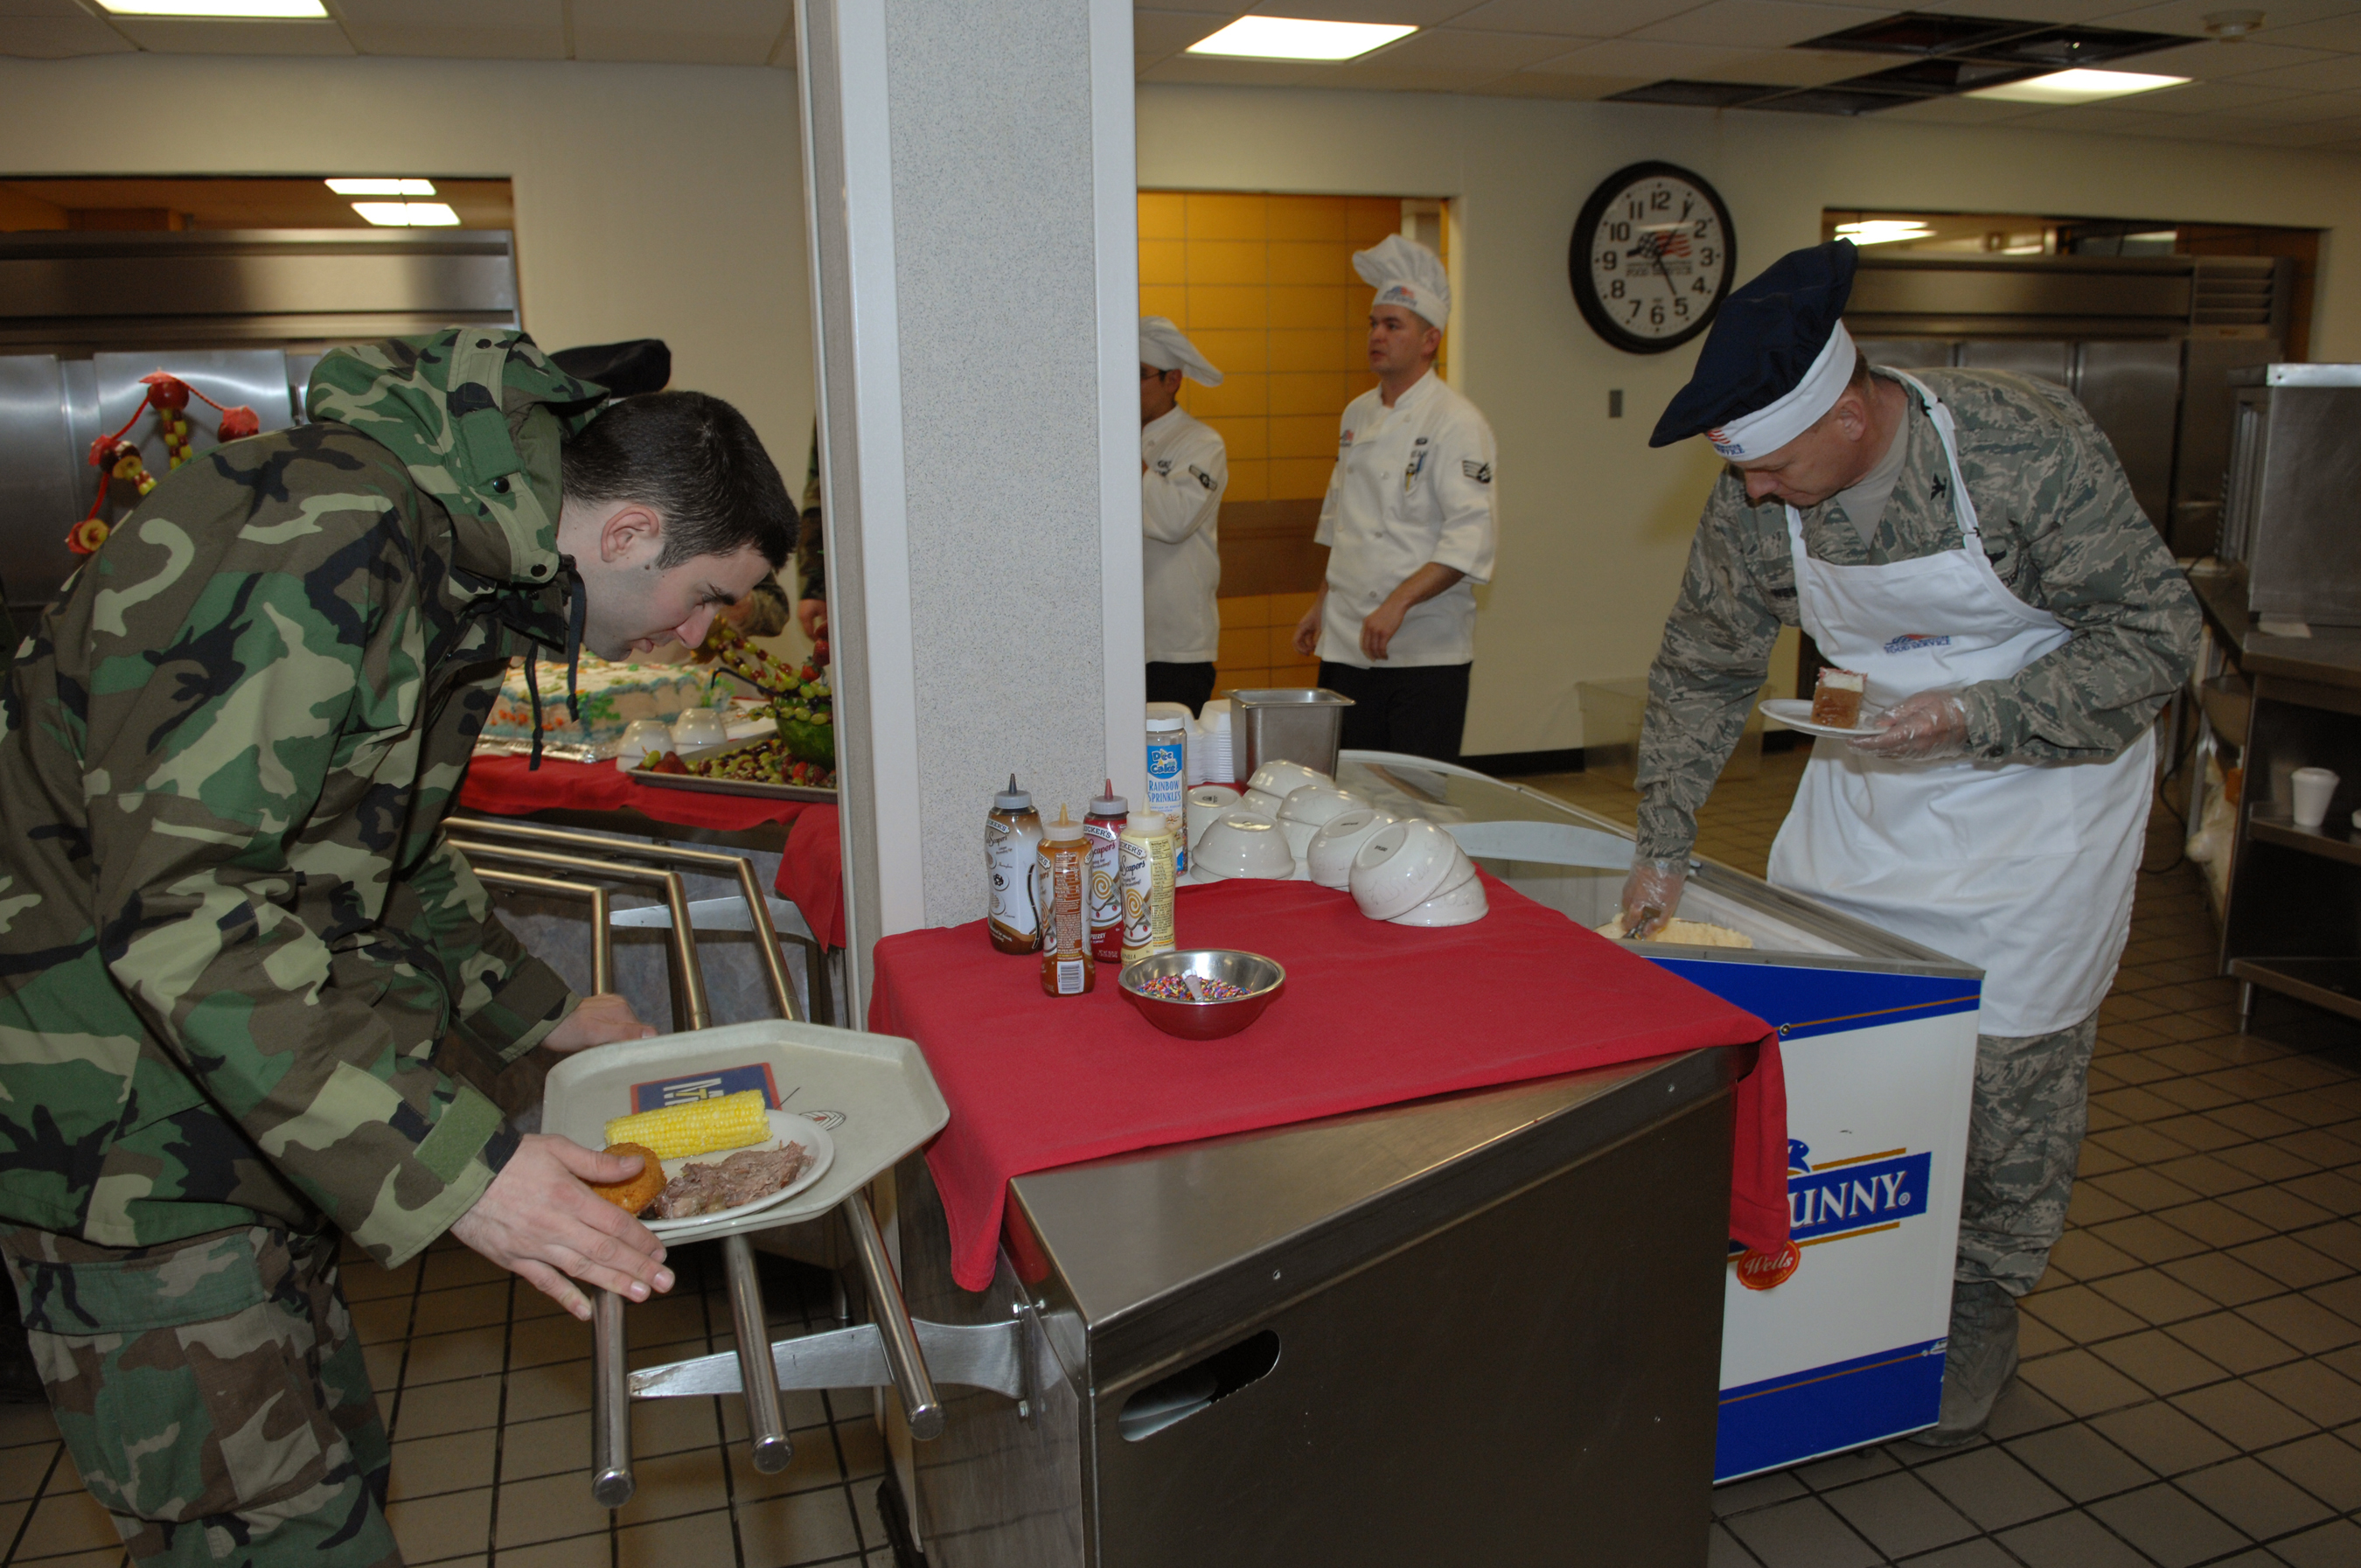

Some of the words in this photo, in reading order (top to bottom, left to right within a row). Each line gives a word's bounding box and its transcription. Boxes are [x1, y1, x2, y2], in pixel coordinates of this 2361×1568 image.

[1629, 200, 1644, 220] 11
[1650, 191, 1671, 211] 12
[1610, 222, 1630, 241] 10
[1695, 220, 1707, 239] 2
[1602, 251, 1617, 270] 9
[1700, 247, 1714, 267] 3
[1611, 279, 1625, 299] 8
[1692, 277, 1706, 295] 4
[1629, 300, 1642, 317] 7
[1650, 305, 1665, 326] 6
[1675, 297, 1689, 317] 5
[1151, 763, 1176, 774] Cake
[1149, 779, 1179, 791] RAINBOW
[1148, 791, 1181, 803] SPRINKLES
[1744, 1251, 1793, 1277] Wells
